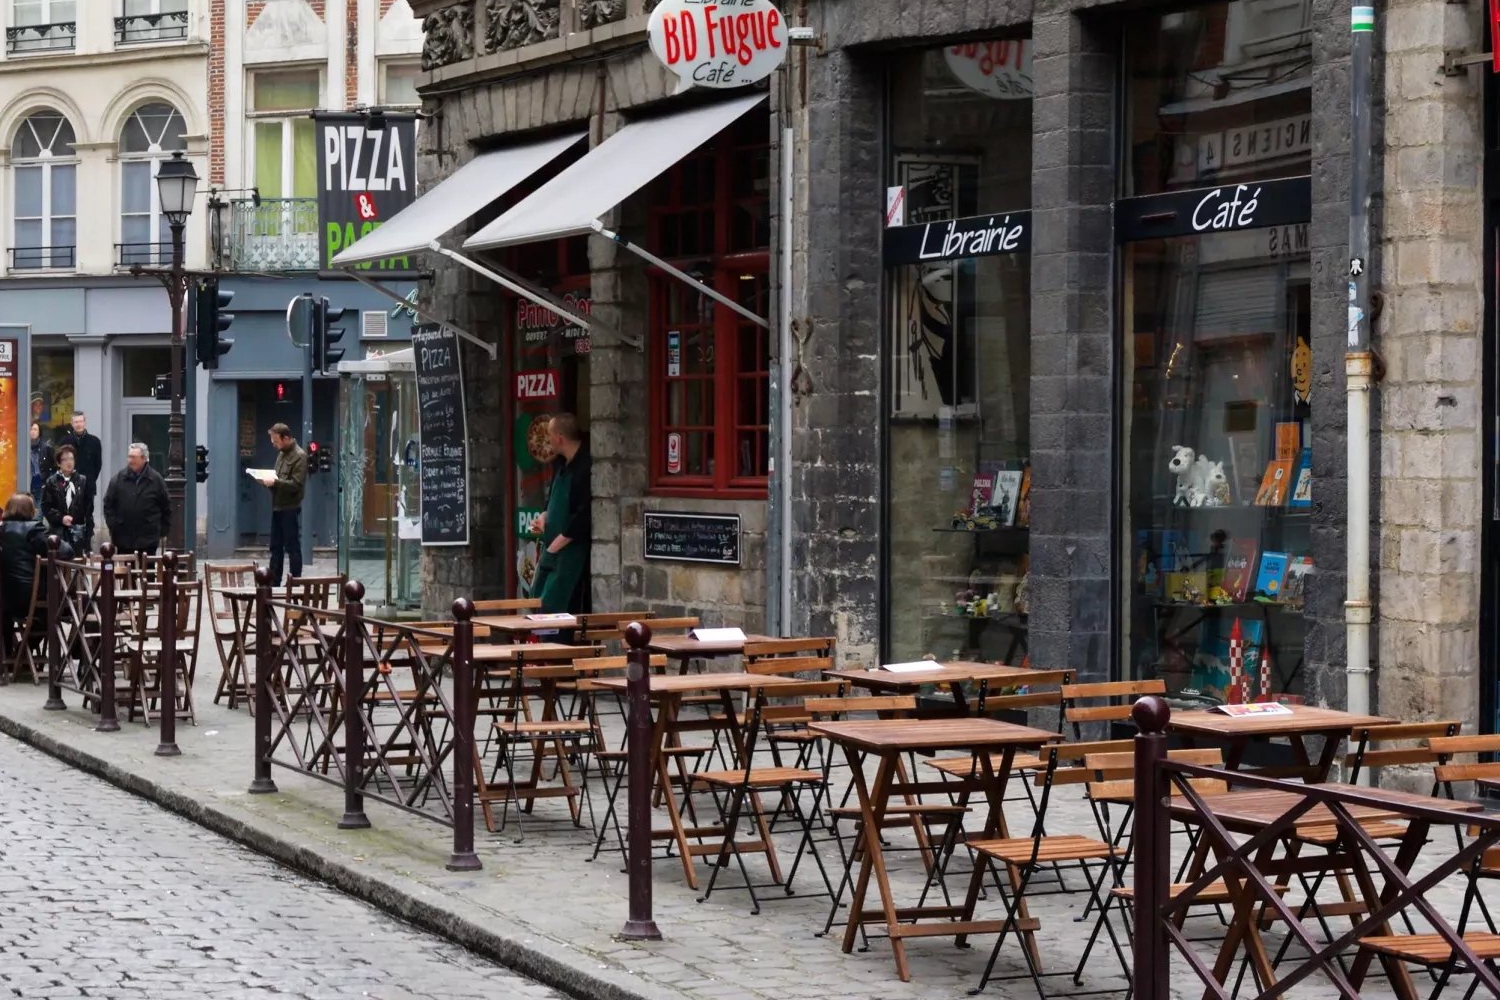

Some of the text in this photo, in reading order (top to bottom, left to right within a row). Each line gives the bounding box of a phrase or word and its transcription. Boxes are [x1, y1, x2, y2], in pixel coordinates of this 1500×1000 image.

[663, 5, 781, 66] BD Fugue
[692, 61, 737, 84] Café
[324, 125, 407, 191] PIZZA
[359, 195, 375, 218] &
[1192, 184, 1262, 231] Café
[919, 215, 1024, 260] Librairie
[0, 343, 6, 354] 3
[421, 347, 452, 372] PIZZA
[517, 373, 556, 397] PIZZA
